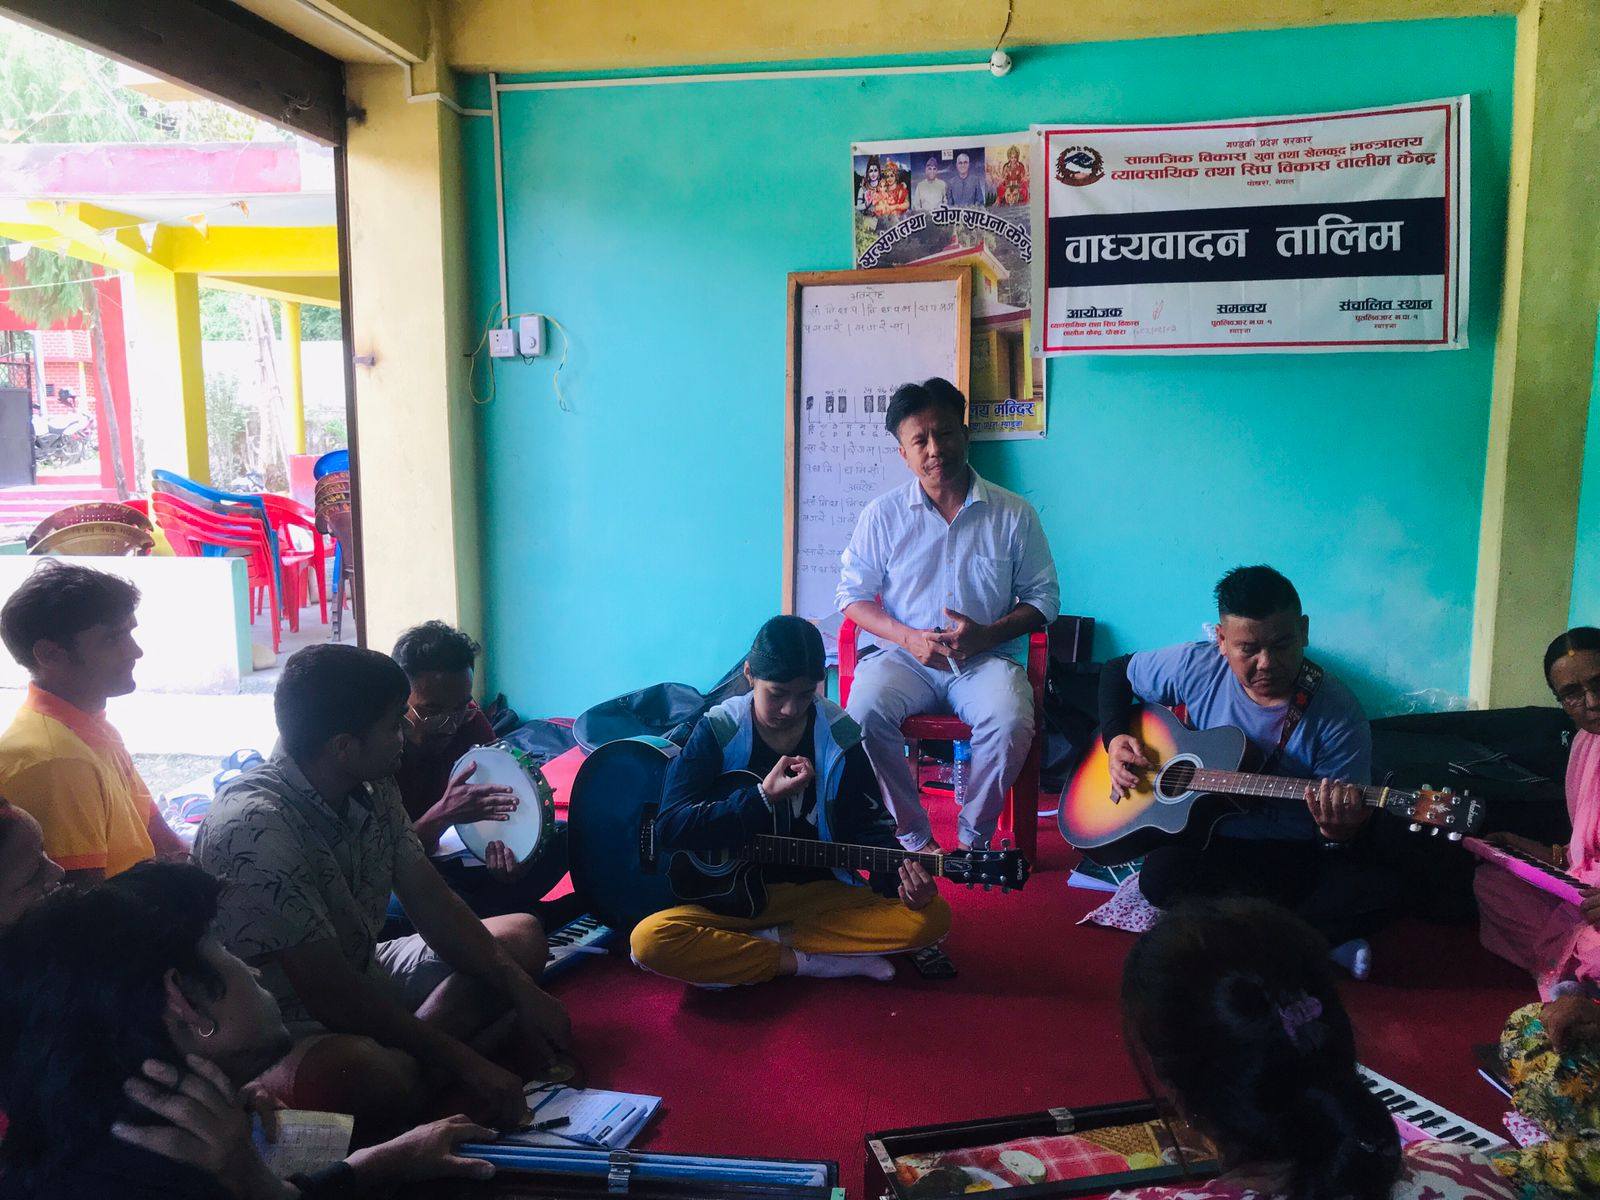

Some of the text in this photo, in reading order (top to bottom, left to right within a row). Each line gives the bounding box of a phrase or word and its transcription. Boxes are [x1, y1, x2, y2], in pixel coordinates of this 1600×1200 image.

[1124, 152, 1194, 165] सामाजिक
[1199, 151, 1247, 163] विकास
[1253, 151, 1274, 163] युवा
[1278, 150, 1299, 160] तथा
[1350, 136, 1424, 151] मन्त्रालय
[1225, 136, 1313, 149] गण्डकी प्रदेश सरकार
[1111, 150, 1438, 181] व्यावसायिक तथा सिप विकास तालीम केन्द्र
[932, 205, 961, 225] योग
[962, 208, 1008, 236] साधना
[1275, 213, 1405, 258] तालिम
[1066, 306, 1123, 319] आयोजक
[1217, 303, 1267, 314] समन्वय
[1339, 297, 1433, 311] संचालित स्थान
[994, 398, 1035, 416] मन्दिर
